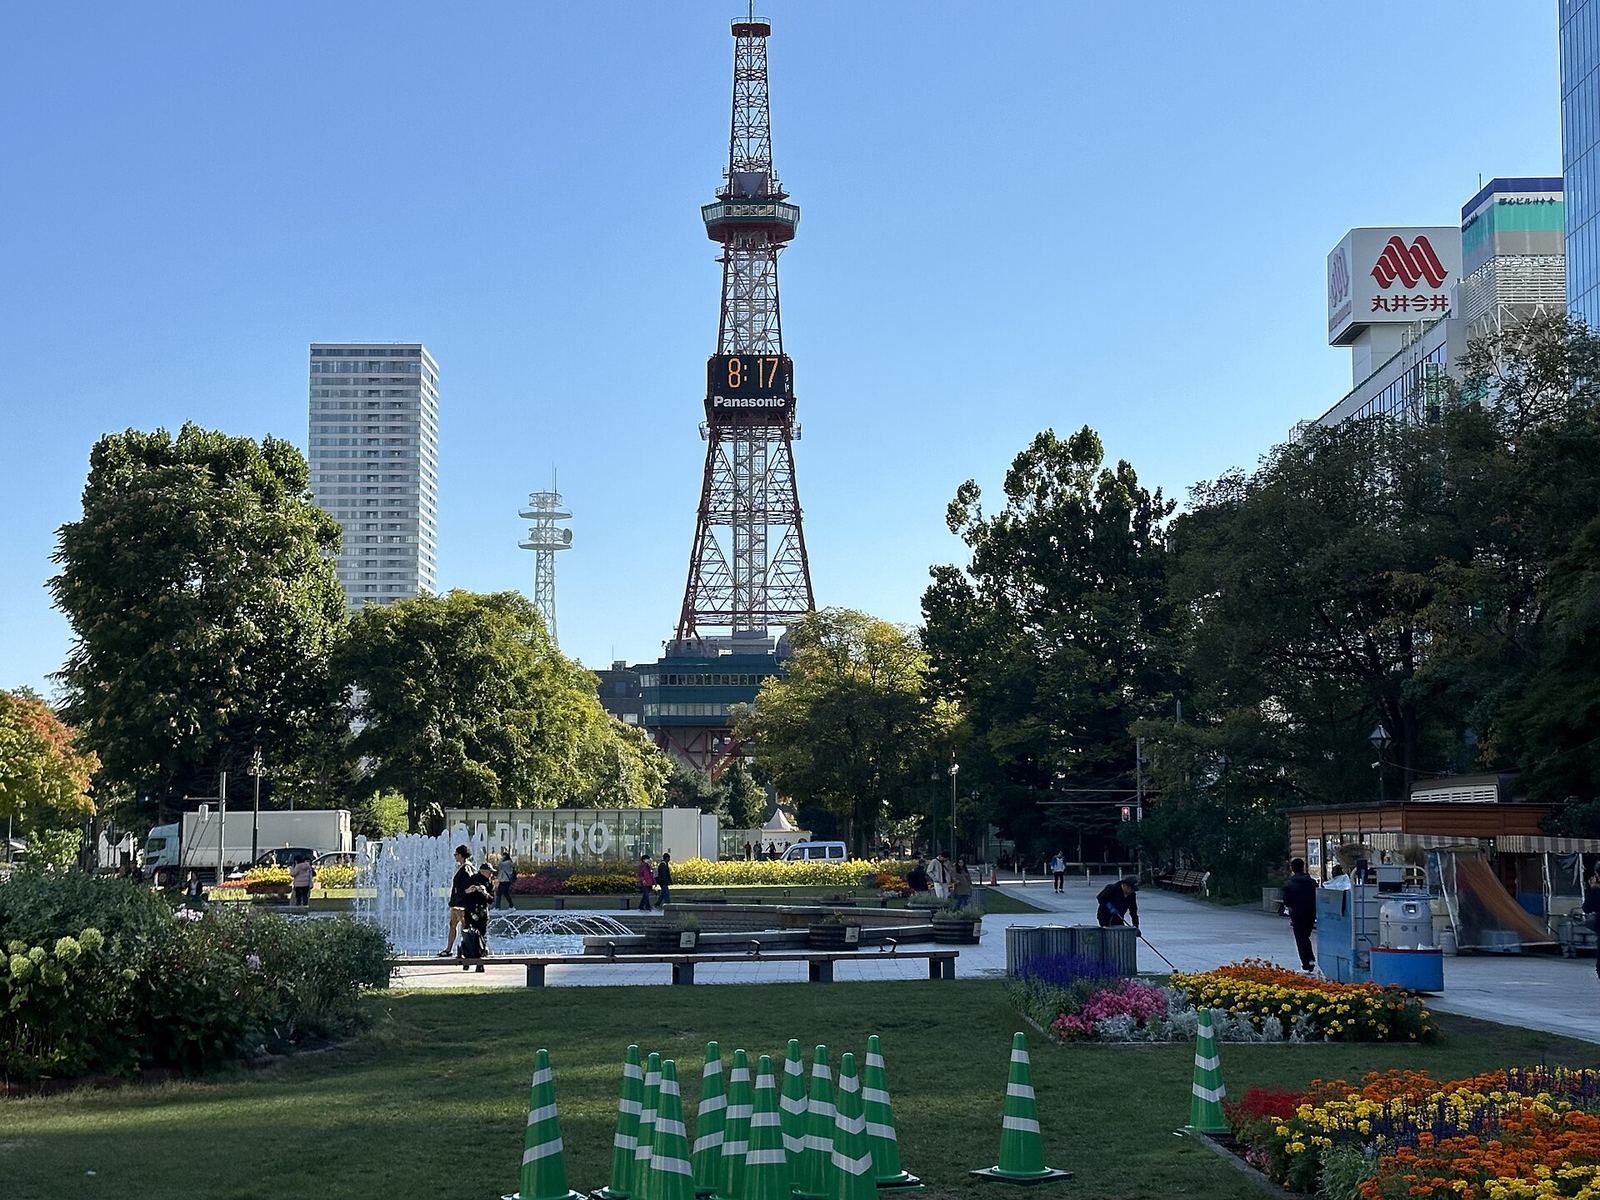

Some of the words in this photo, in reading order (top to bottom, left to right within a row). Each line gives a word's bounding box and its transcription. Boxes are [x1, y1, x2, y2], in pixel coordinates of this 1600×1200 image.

[1371, 294, 1449, 312] 丸井今井
[713, 395, 786, 407] Panasonic
